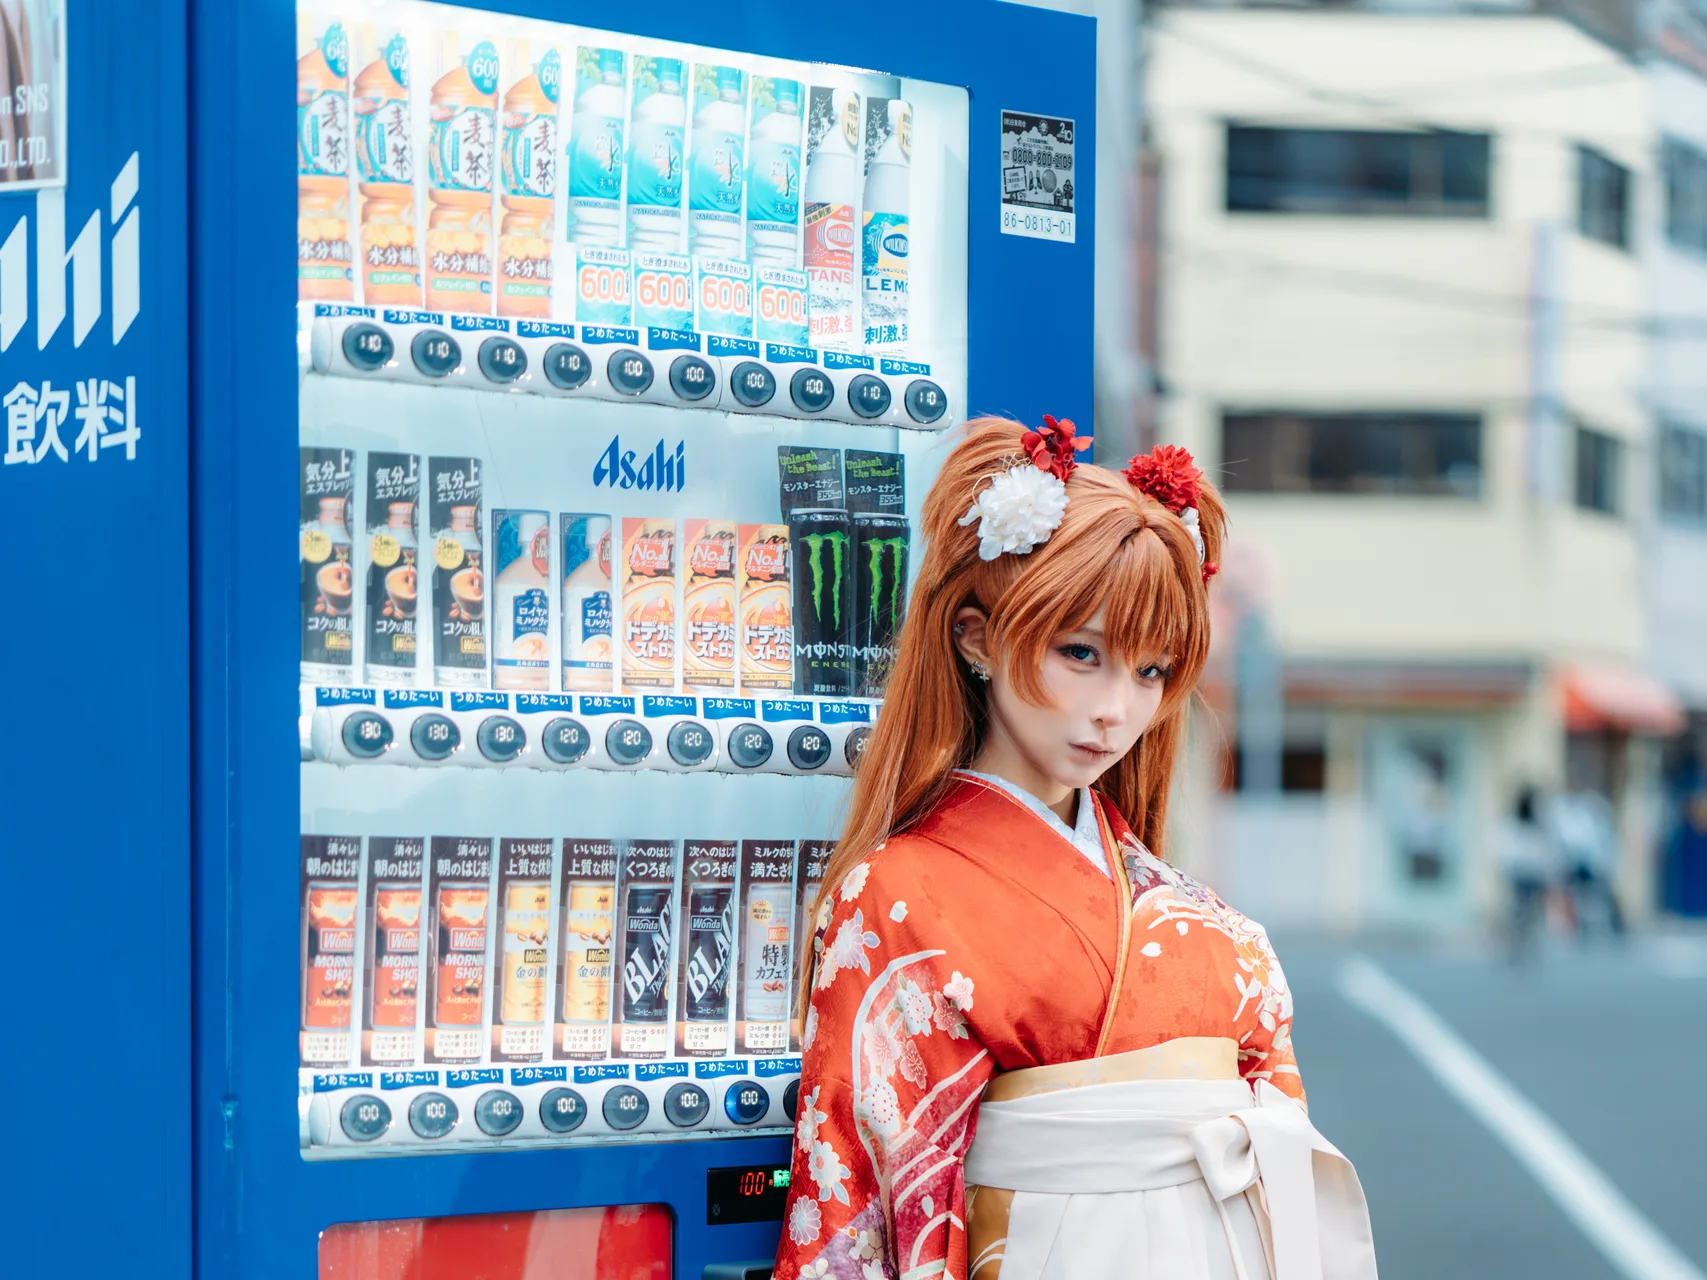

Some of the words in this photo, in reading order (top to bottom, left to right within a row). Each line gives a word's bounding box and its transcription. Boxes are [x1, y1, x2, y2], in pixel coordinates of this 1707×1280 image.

[15, 83, 49, 116] SNS
[321, 95, 347, 172] 麦茶
[386, 104, 412, 179] 麦茶
[462, 112, 488, 187] 麦茶
[533, 119, 555, 193] 麦茶
[1012, 146, 1073, 172] 0800-800-2109
[1003, 211, 1072, 236] 86-0813-01
[580, 267, 625, 302] 600
[807, 268, 853, 285] TANS
[639, 274, 686, 308] 600
[702, 278, 746, 313] 600
[760, 288, 803, 322] 600
[360, 334, 382, 352] 110
[427, 341, 449, 359] 110
[495, 347, 516, 365] 110
[559, 354, 581, 371] 110
[624, 360, 643, 377] 100
[686, 366, 705, 382] 100
[747, 372, 765, 389] 100
[806, 378, 824, 395] 100
[863, 385, 881, 400] 110
[919, 390, 937, 406] 110
[3, 375, 142, 466] 飲料
[592, 433, 685, 493] Asahi
[779, 450, 818, 466] Unleash
[845, 457, 883, 470] Unleash
[787, 464, 806, 475] the
[852, 470, 870, 478] the
[783, 480, 841, 492] モンスターエナジー
[847, 483, 903, 496] モンスターエナジー
[630, 538, 670, 562] No.1
[692, 539, 731, 562] No.1
[746, 543, 784, 566] No.1
[795, 640, 852, 660] MONST
[361, 720, 382, 740] 130
[428, 723, 449, 741] 130
[494, 725, 515, 743] 130
[559, 728, 579, 744] 120
[622, 729, 641, 746] 120
[684, 731, 703, 747] 120
[744, 734, 762, 749] 120
[802, 735, 820, 751] 120
[629, 918, 658, 930] Wonda
[692, 917, 721, 929] Wonda
[557, 1097, 576, 1113] 100
[619, 1095, 638, 1110] 100
[680, 1092, 699, 1108] 100
[740, 1090, 759, 1106] 100
[359, 1104, 380, 1122] 100
[426, 1101, 447, 1119] 100
[492, 1099, 512, 1116] 100
[739, 1171, 766, 1196] 100
